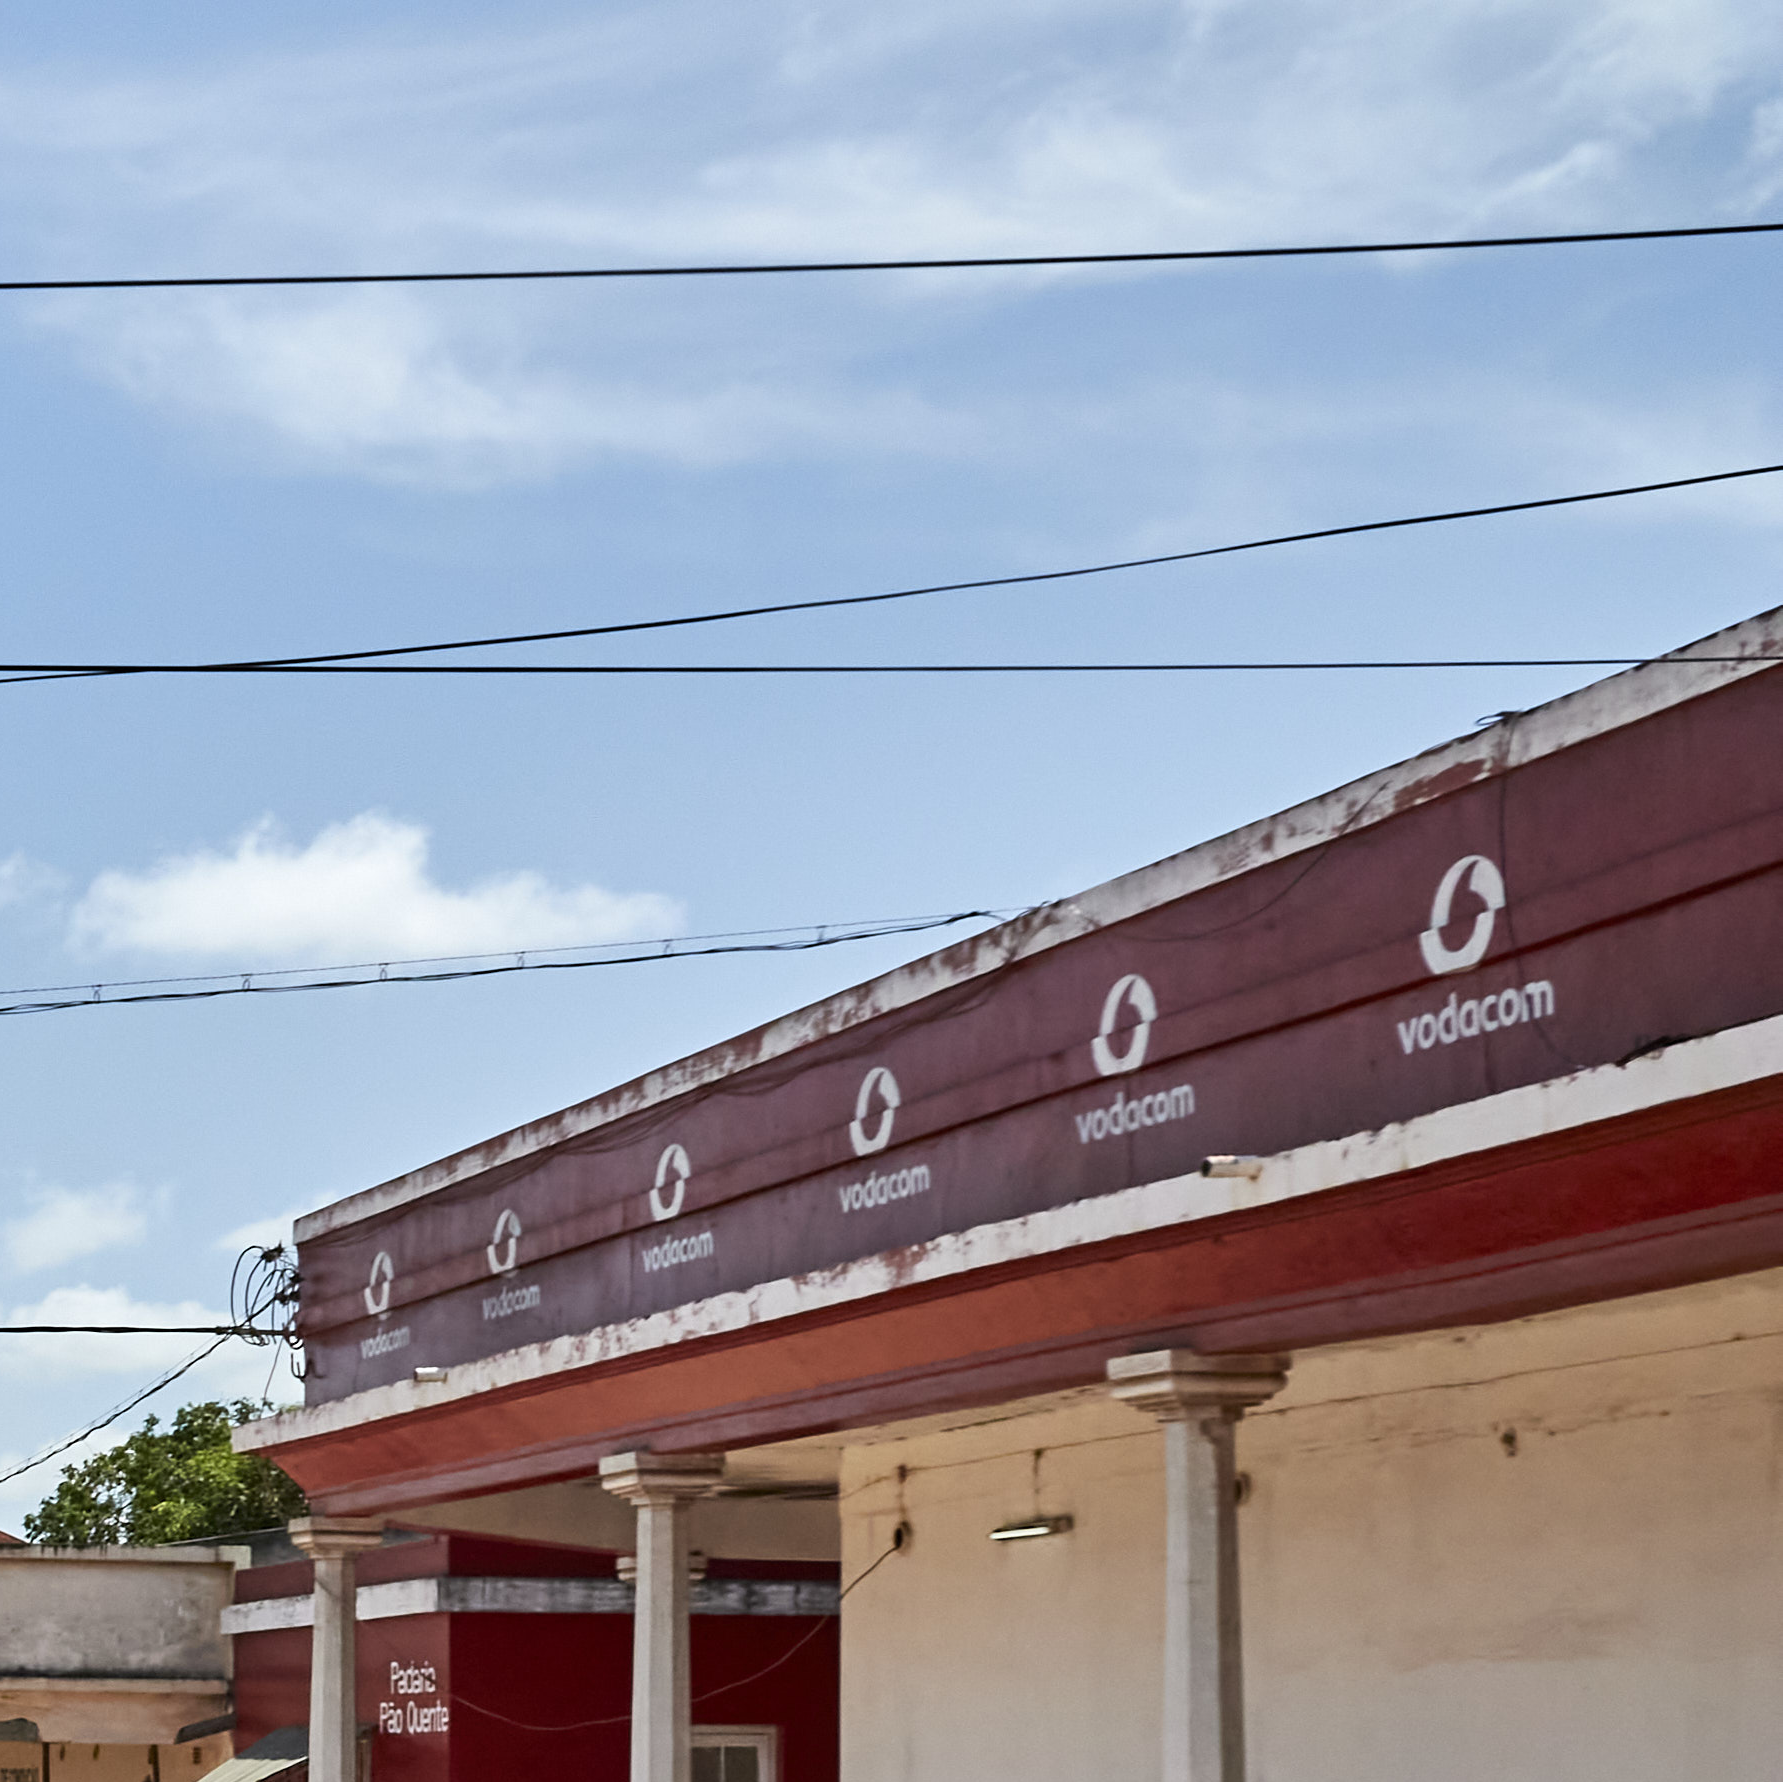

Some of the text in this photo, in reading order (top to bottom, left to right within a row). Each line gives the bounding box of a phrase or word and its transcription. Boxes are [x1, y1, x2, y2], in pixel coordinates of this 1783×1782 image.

[1397, 978, 1555, 1054] vodacom
[1074, 1083, 1195, 1144] vodacom
[839, 1161, 931, 1212] vodacom
[641, 1230, 714, 1273] vodacom
[482, 1284, 541, 1321] vodacom
[360, 1324, 411, 1360] vodacom
[379, 1699, 449, 1735] Pão Quente
